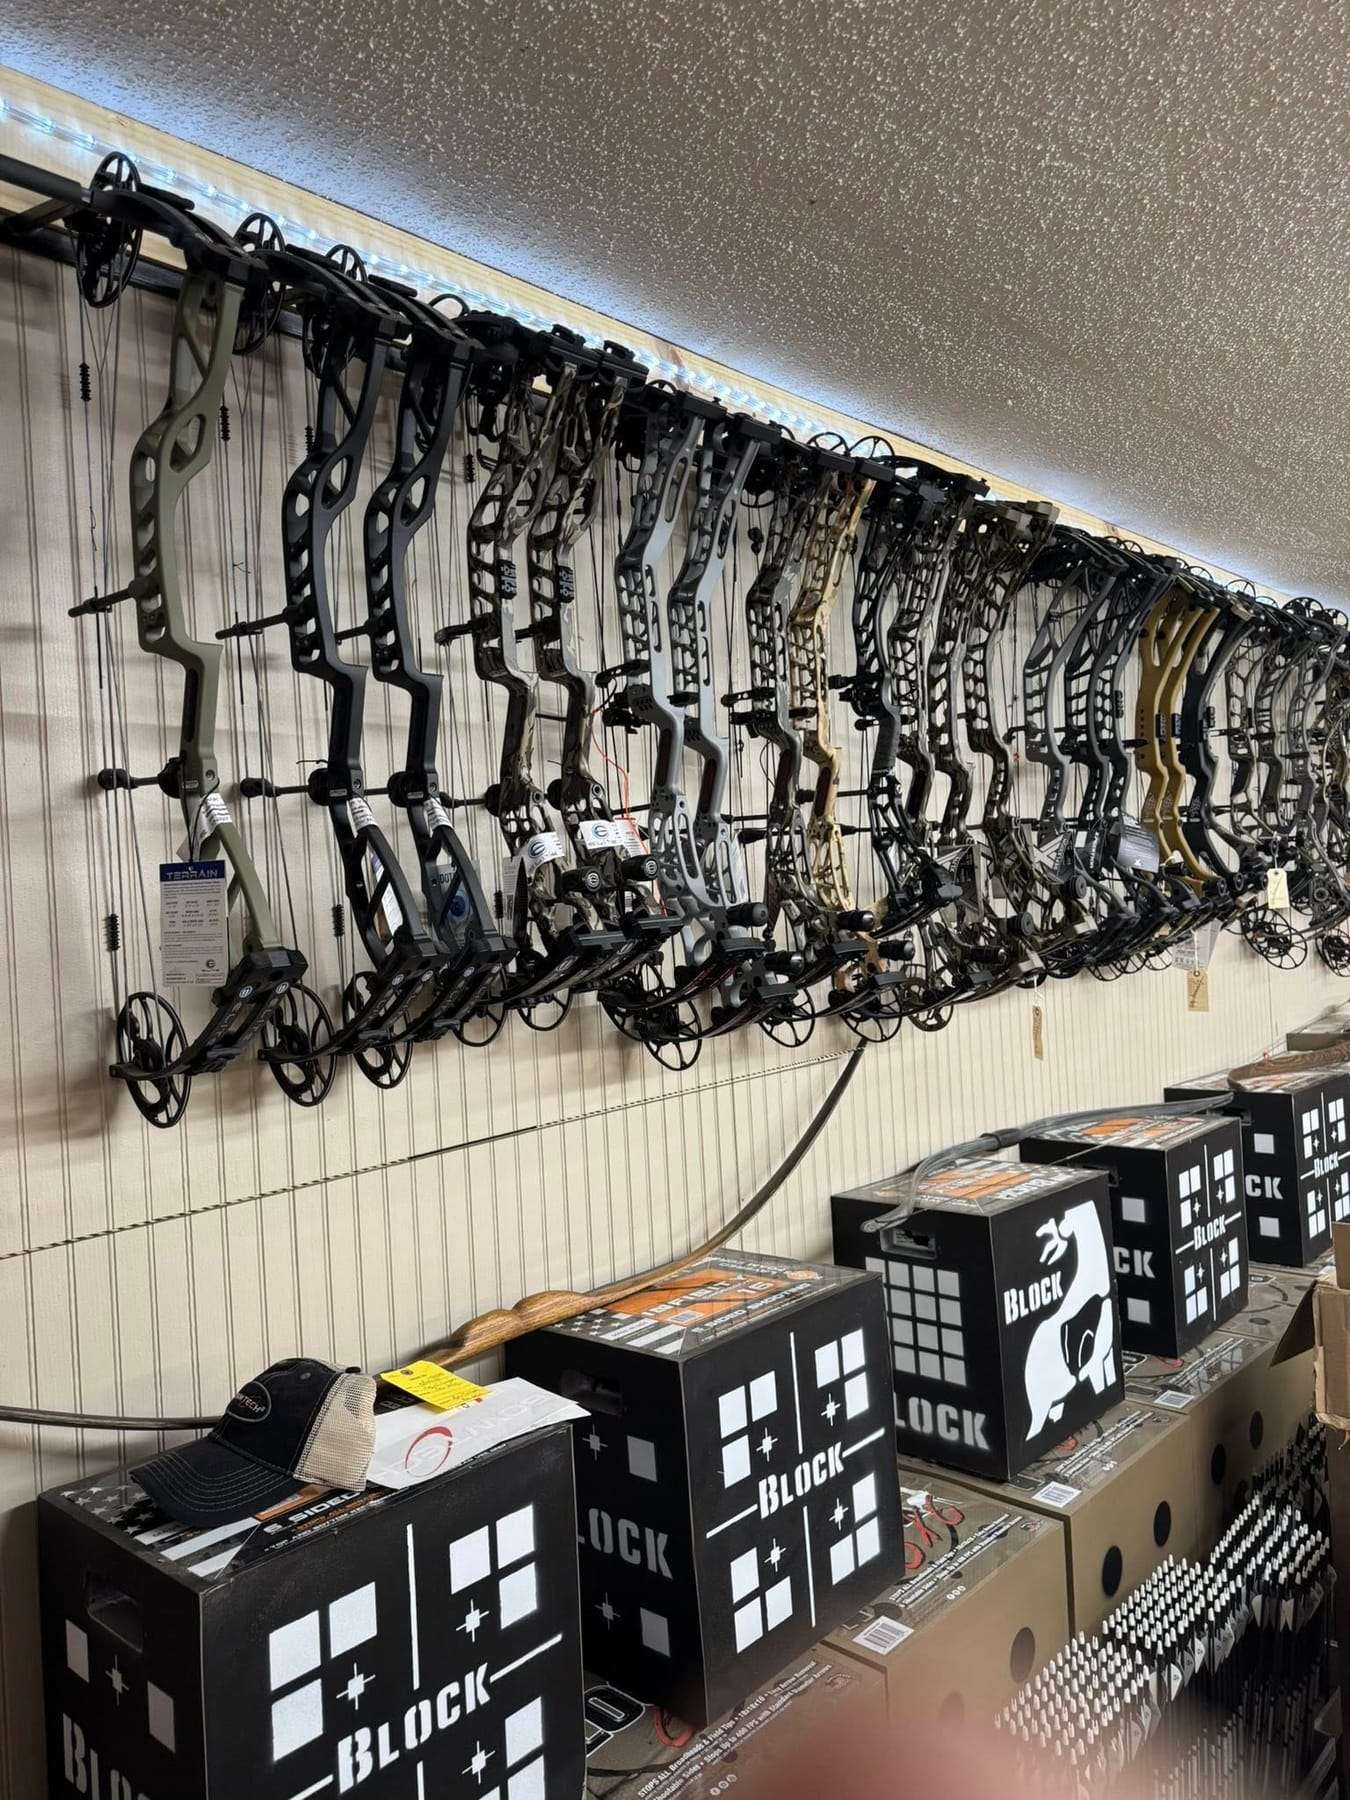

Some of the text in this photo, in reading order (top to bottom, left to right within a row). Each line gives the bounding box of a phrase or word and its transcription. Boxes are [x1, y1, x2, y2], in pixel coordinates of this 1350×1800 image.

[165, 869, 219, 880] TERRAIN
[1314, 1151, 1339, 1179] BLOCK
[1194, 1214, 1226, 1251] BLOCK
[1003, 1270, 1064, 1326] BLOCK
[758, 1441, 845, 1520] BLOCK
[578, 1508, 673, 1580] OCK
[337, 1662, 491, 1795] BLOCK
[637, 1777, 661, 1798] STOPS
[657, 1767, 673, 1781] ALL
[668, 1743, 705, 1772] Broadheads
